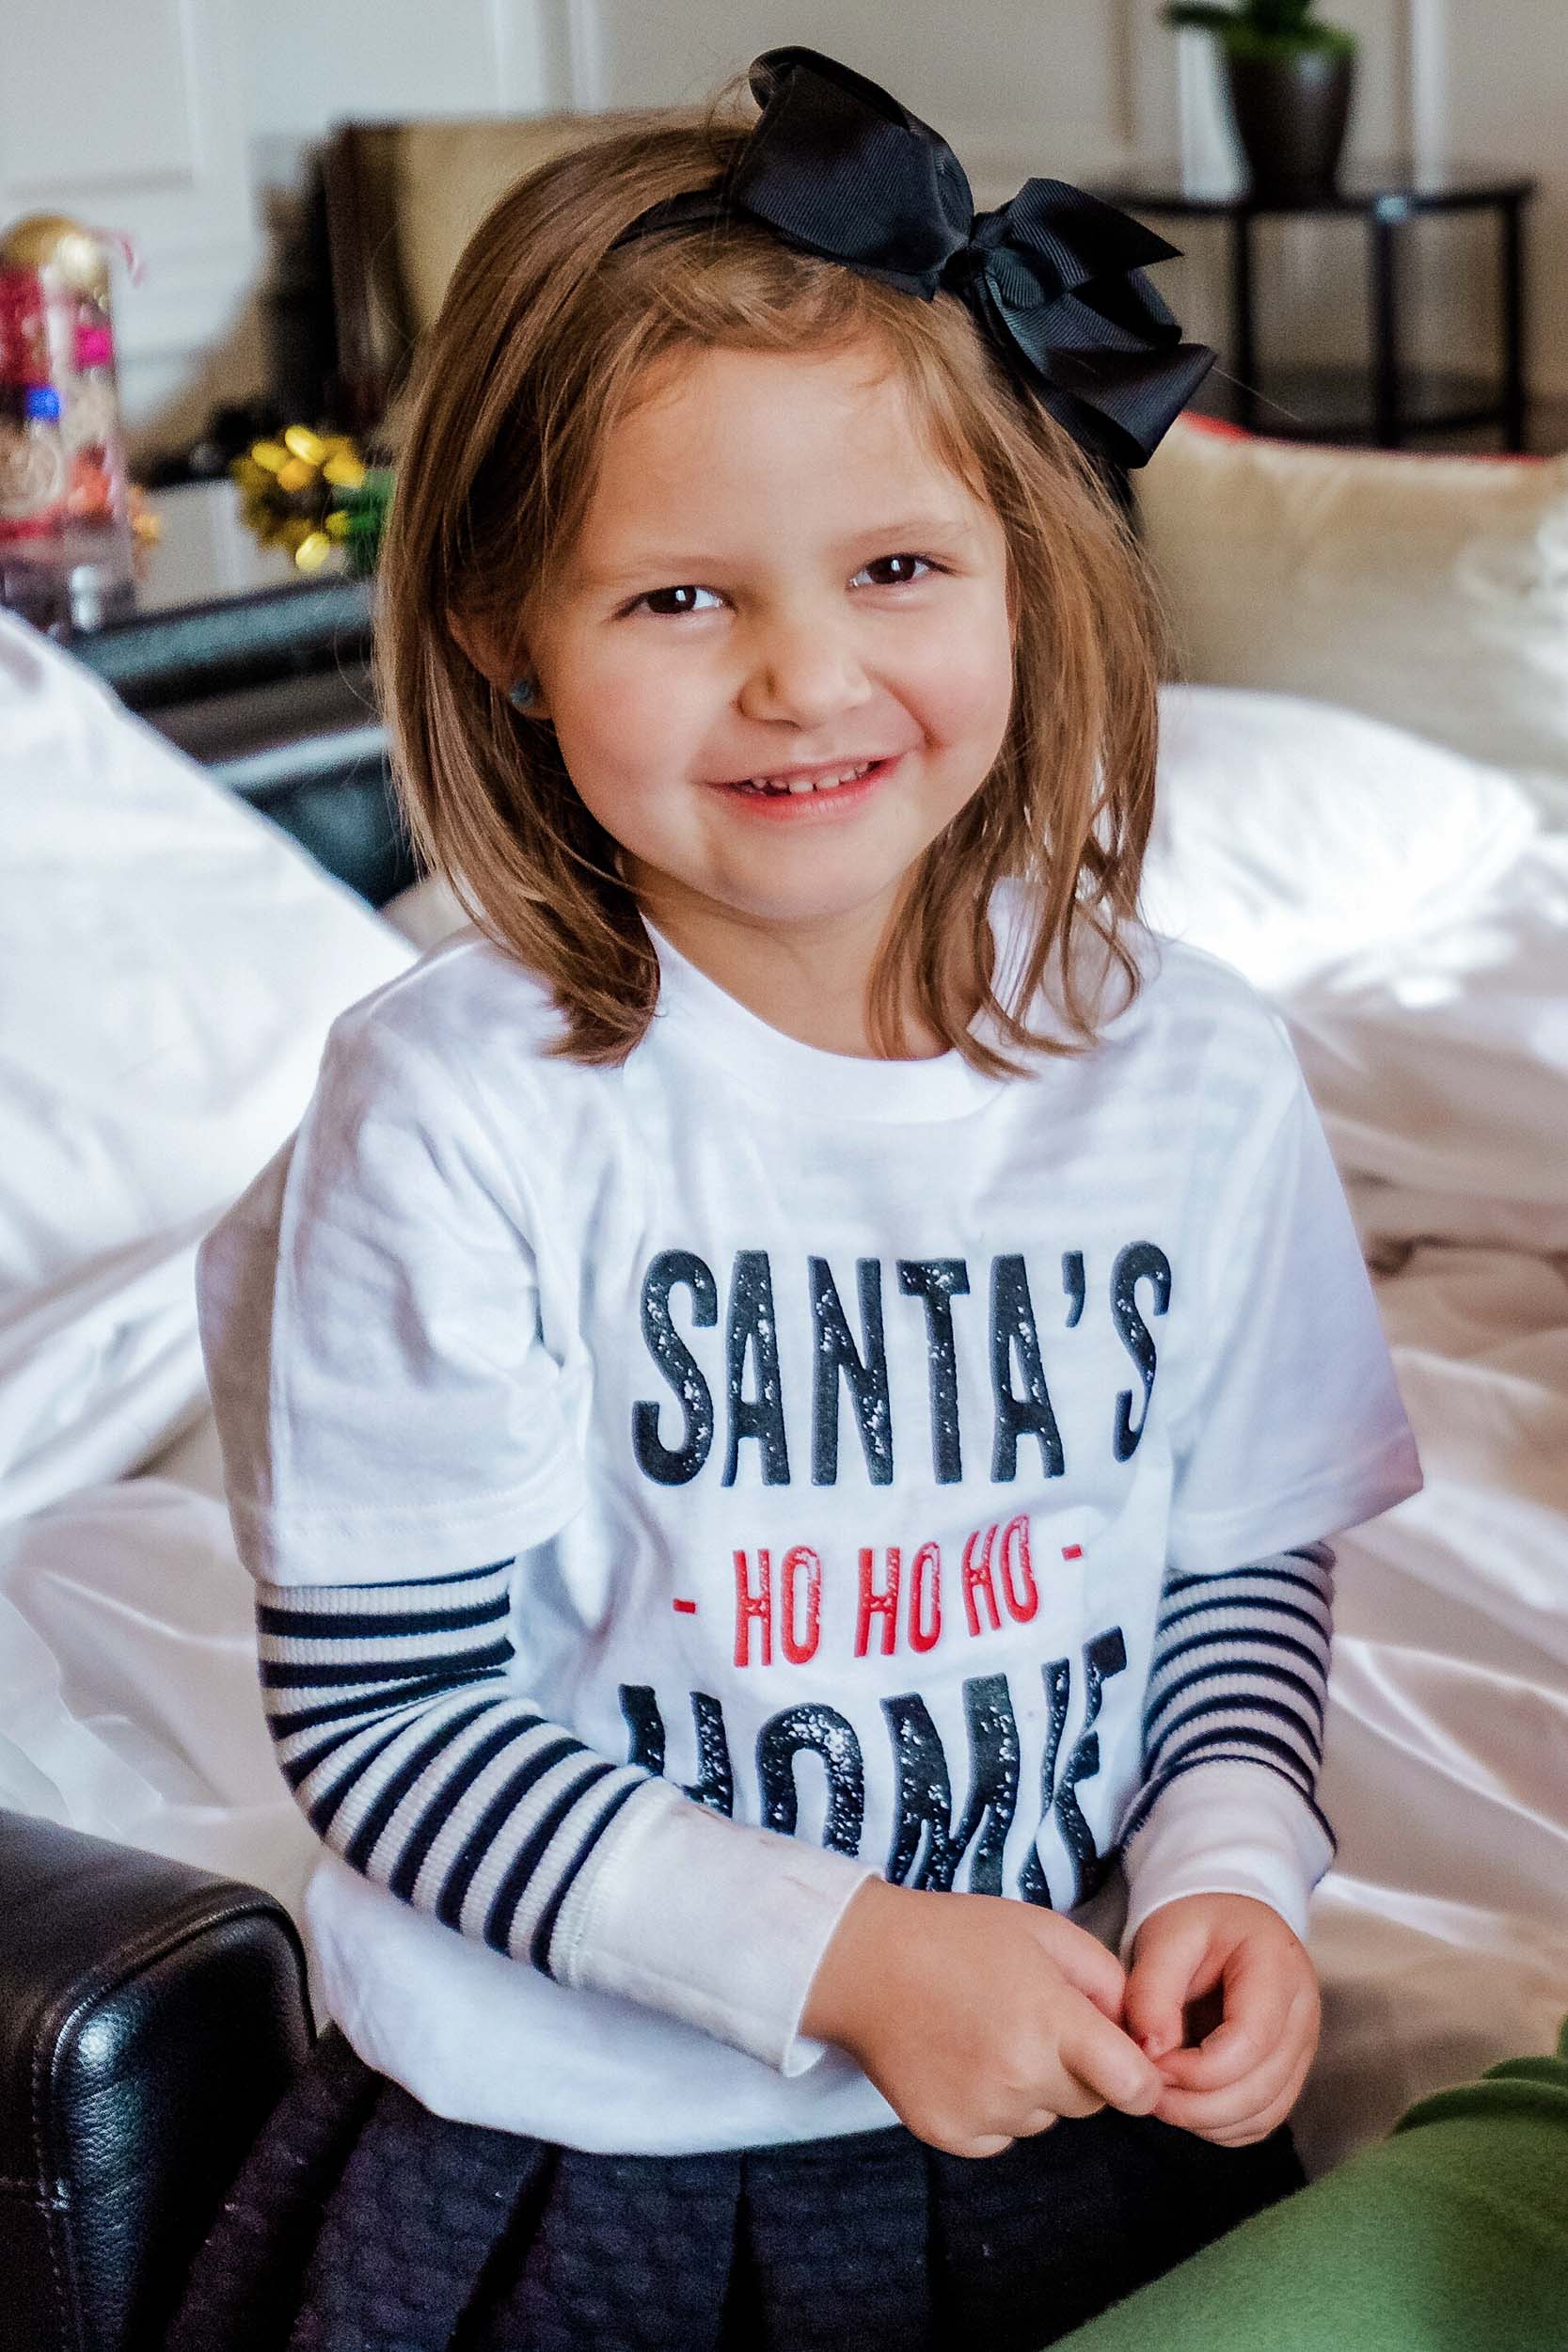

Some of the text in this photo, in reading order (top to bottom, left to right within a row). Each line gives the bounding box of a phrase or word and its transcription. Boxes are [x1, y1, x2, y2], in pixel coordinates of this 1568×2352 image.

[632, 1241, 1172, 1486] SANTA'S
[733, 1545, 824, 1667] HO
[854, 1541, 942, 1657] HO
[960, 1513, 1039, 1637] HO
